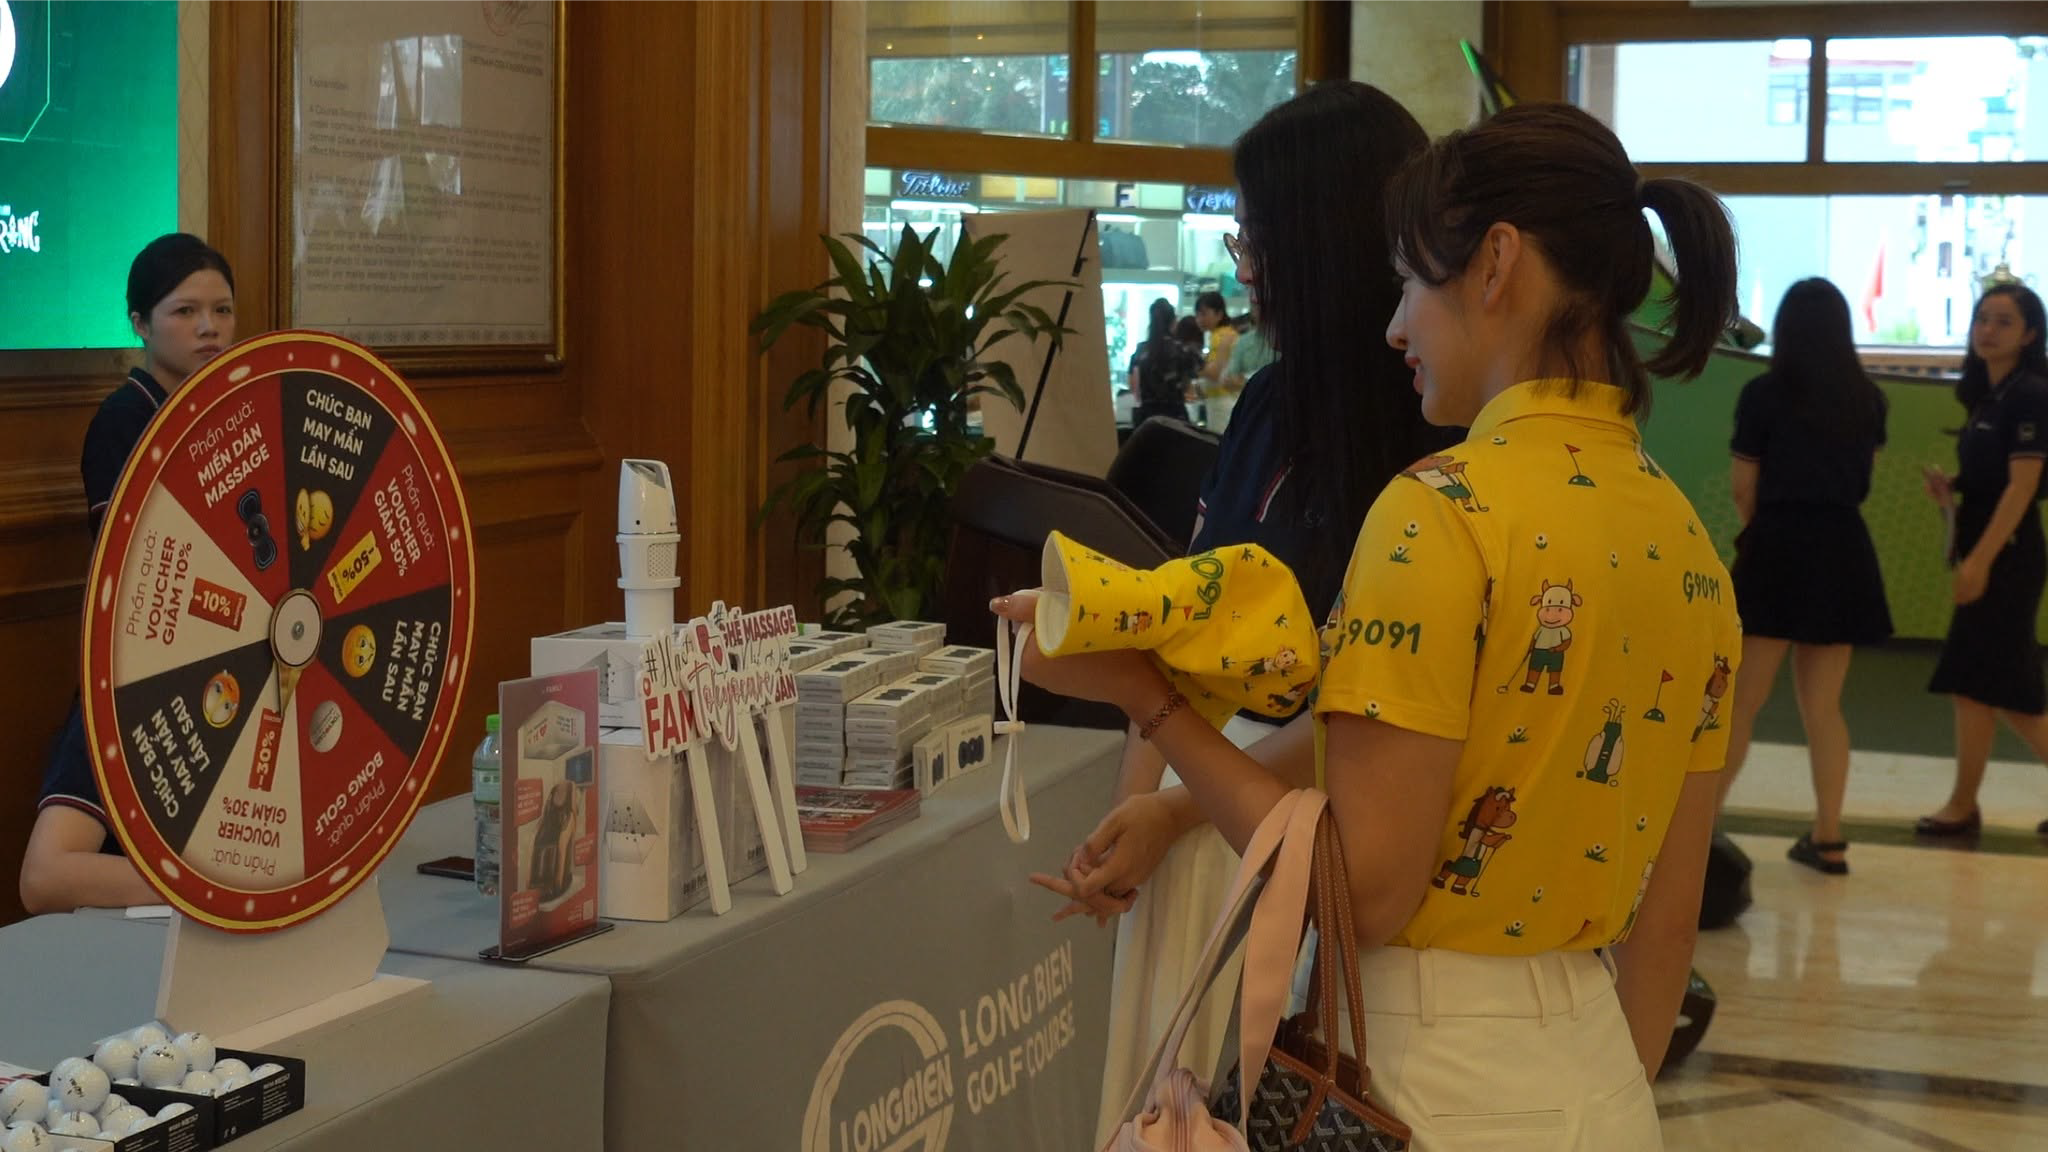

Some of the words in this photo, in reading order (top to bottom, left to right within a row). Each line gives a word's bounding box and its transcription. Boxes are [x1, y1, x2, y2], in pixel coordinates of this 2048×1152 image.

[225, 400, 255, 433] quà:
[304, 417, 331, 442] MAY
[306, 389, 344, 417] CHÚC
[345, 405, 372, 430] BẠN
[231, 422, 263, 461] DÁN
[204, 444, 270, 509] MASSAGE
[328, 458, 354, 481] SAU
[387, 477, 421, 565] VOUCHER
[174, 543, 192, 584] 10%
[390, 537, 409, 577] 50%
[145, 536, 177, 641] VOUCHER
[193, 588, 231, 618] -10%
[1682, 570, 1721, 605] G9091
[407, 620, 425, 664] MAY
[743, 608, 796, 642] MASSAGE
[421, 621, 442, 676] CHÚC
[382, 662, 398, 702] SAU
[412, 682, 430, 721] BẠN
[171, 695, 194, 735] SAU
[171, 756, 196, 796] MAY
[256, 730, 276, 787] -30%
[347, 751, 384, 796] BÓNG
[149, 765, 179, 818] CHÚC
[222, 796, 251, 817] 30%
[218, 820, 281, 848] VOUCHER
[314, 793, 348, 836] GOLF
[958, 973, 1032, 1059] LONG
[1034, 939, 1074, 1009] BIEN
[967, 1046, 1025, 1116] GOLF
[1026, 1000, 1076, 1079] COURSE
